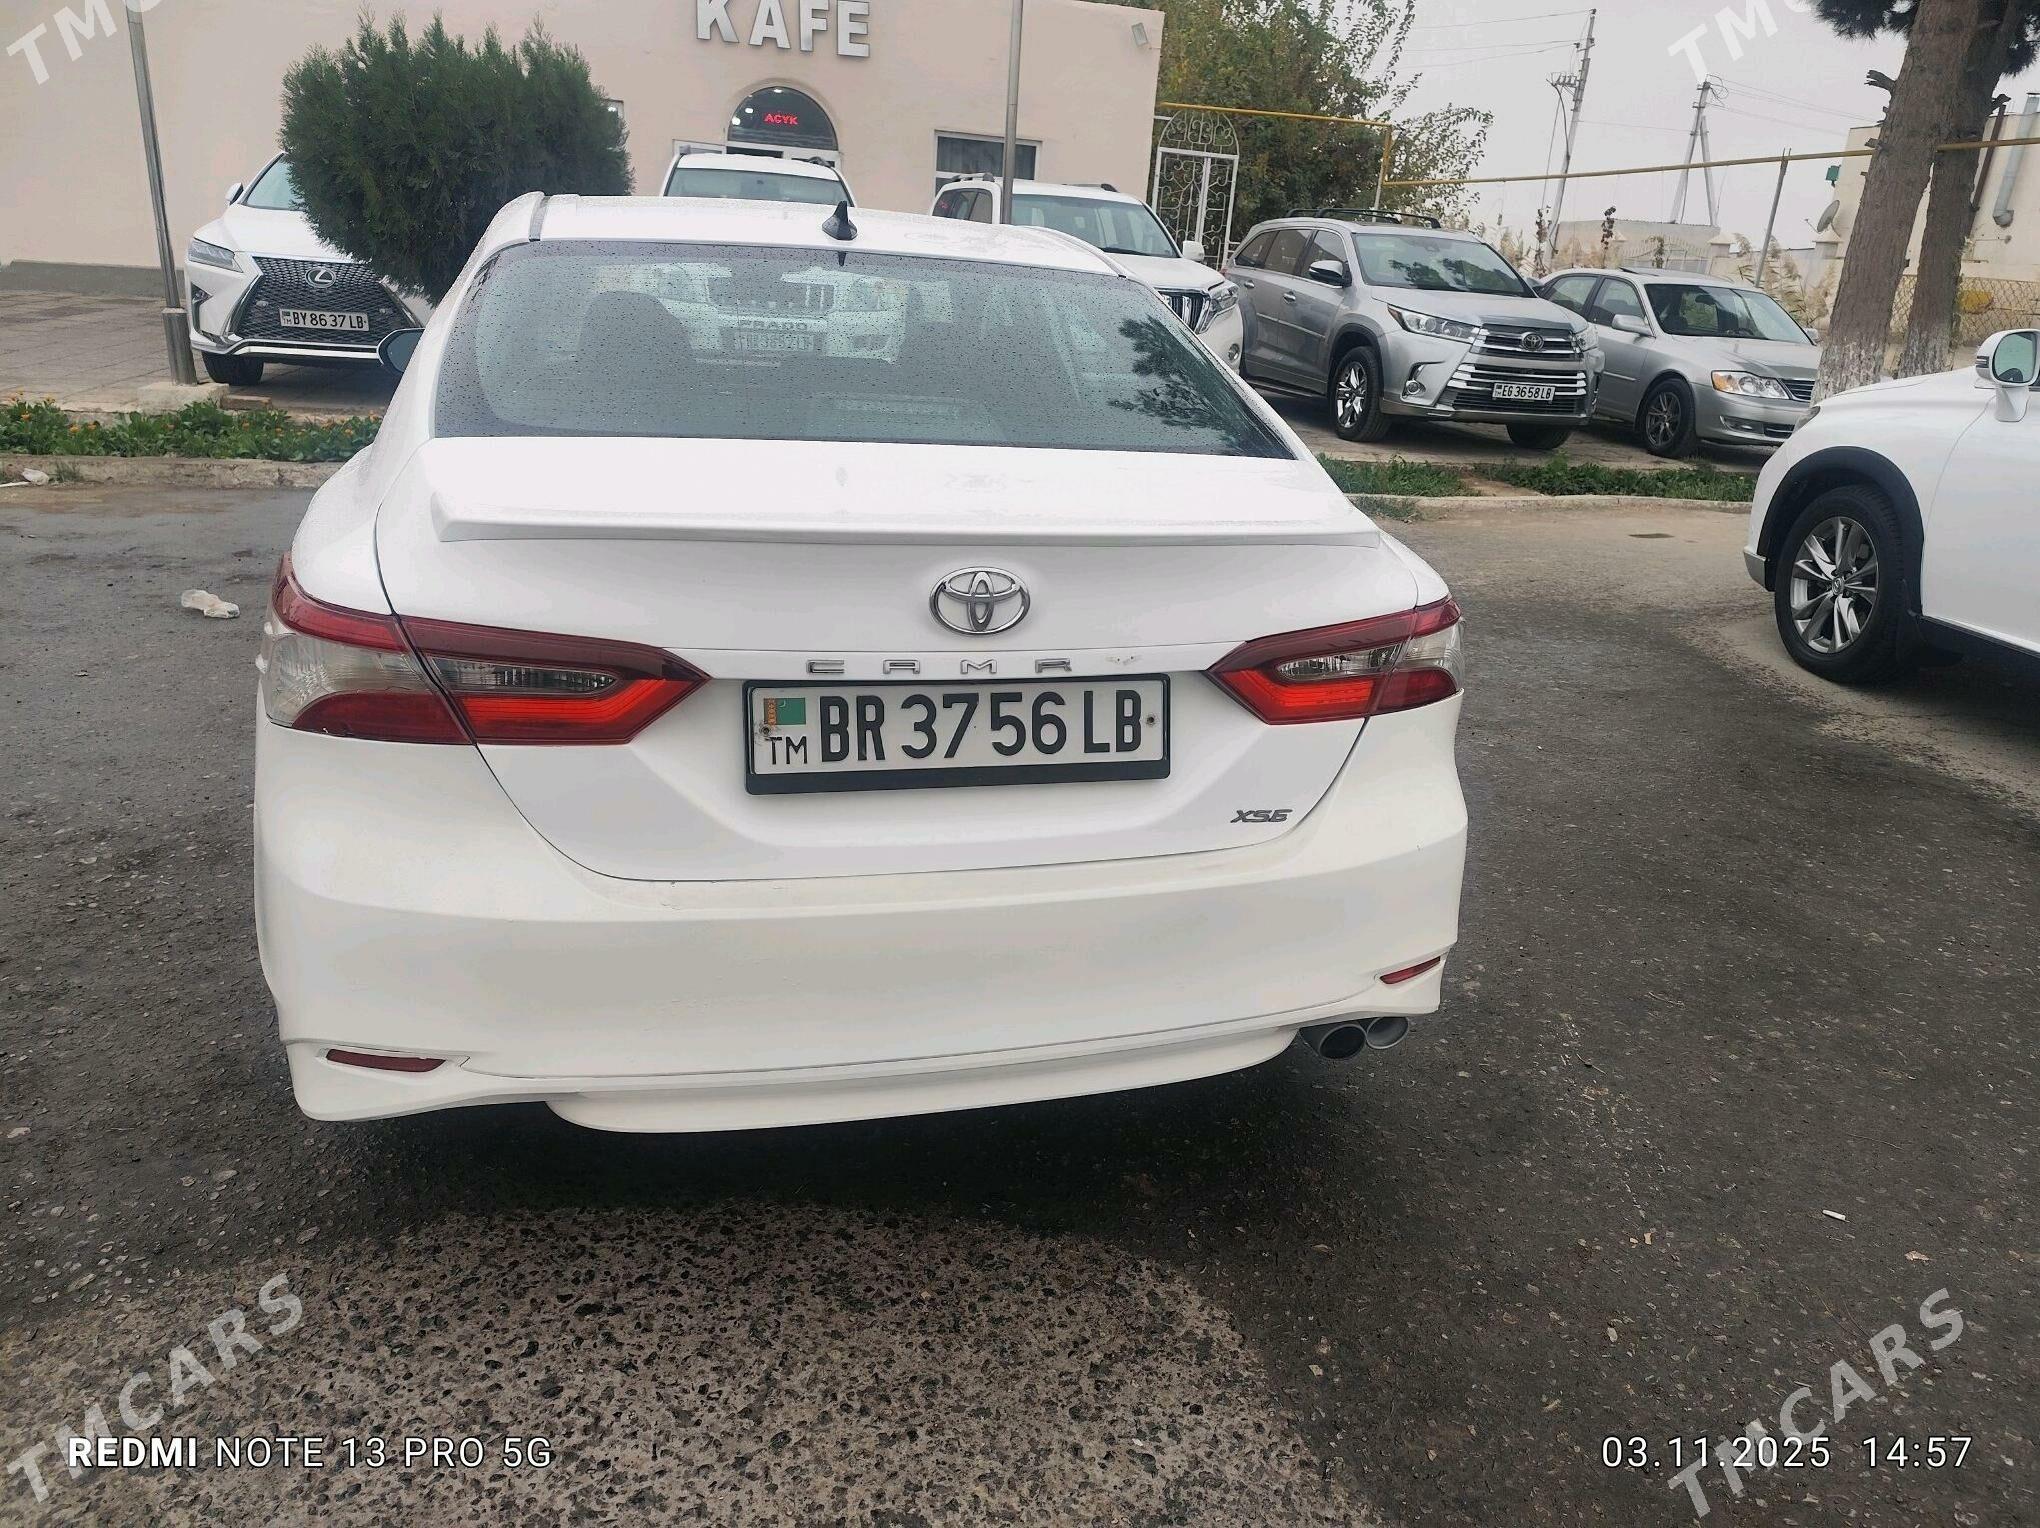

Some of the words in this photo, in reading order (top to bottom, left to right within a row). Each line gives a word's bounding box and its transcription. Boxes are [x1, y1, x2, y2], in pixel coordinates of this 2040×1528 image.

[697, 0, 870, 57] KAFE
[292, 312, 307, 325] BY
[310, 313, 346, 327] 8637
[349, 315, 364, 329] LB
[1502, 385, 1513, 397] EG
[1514, 386, 1540, 398] 3658
[1541, 387, 1552, 399] LB
[765, 736, 808, 765] TM
[820, 695, 886, 763] BR
[900, 691, 1067, 759] 3756
[1084, 689, 1142, 754] LB
[1230, 808, 1293, 823] XSE
